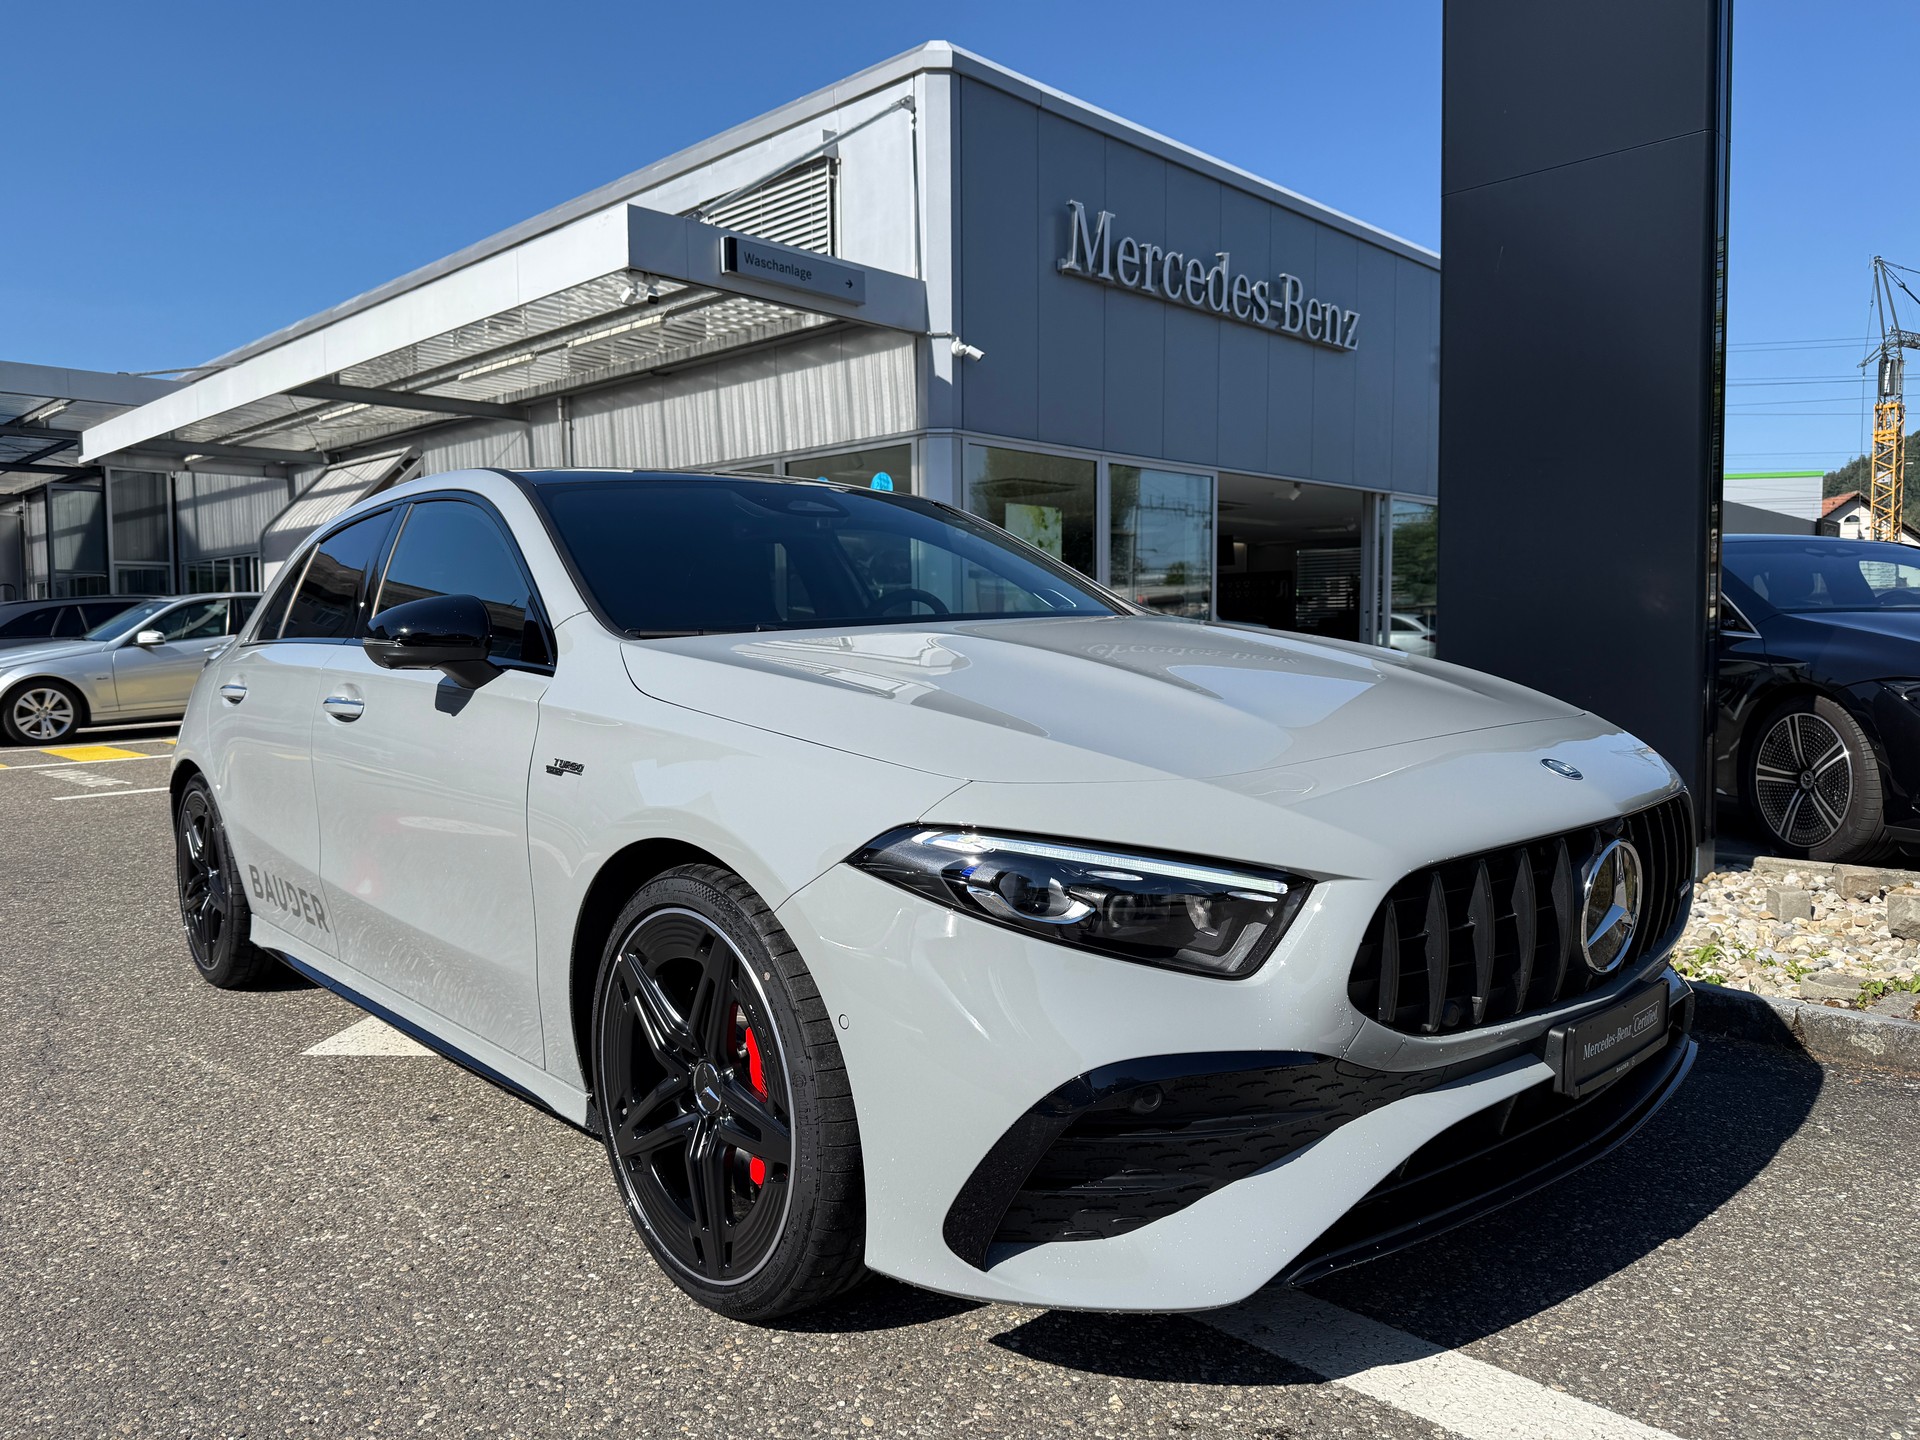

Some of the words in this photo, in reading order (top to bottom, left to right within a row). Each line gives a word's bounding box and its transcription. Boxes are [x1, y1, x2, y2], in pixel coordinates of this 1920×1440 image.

[744, 251, 812, 281] Waschanlage
[1056, 199, 1361, 351] Mercedes-Benz
[554, 757, 585, 772] TURBO
[248, 864, 331, 933] BAUDER
[1583, 1025, 1632, 1061] Mercedes-Benz
[1633, 1005, 1659, 1032] Certified
